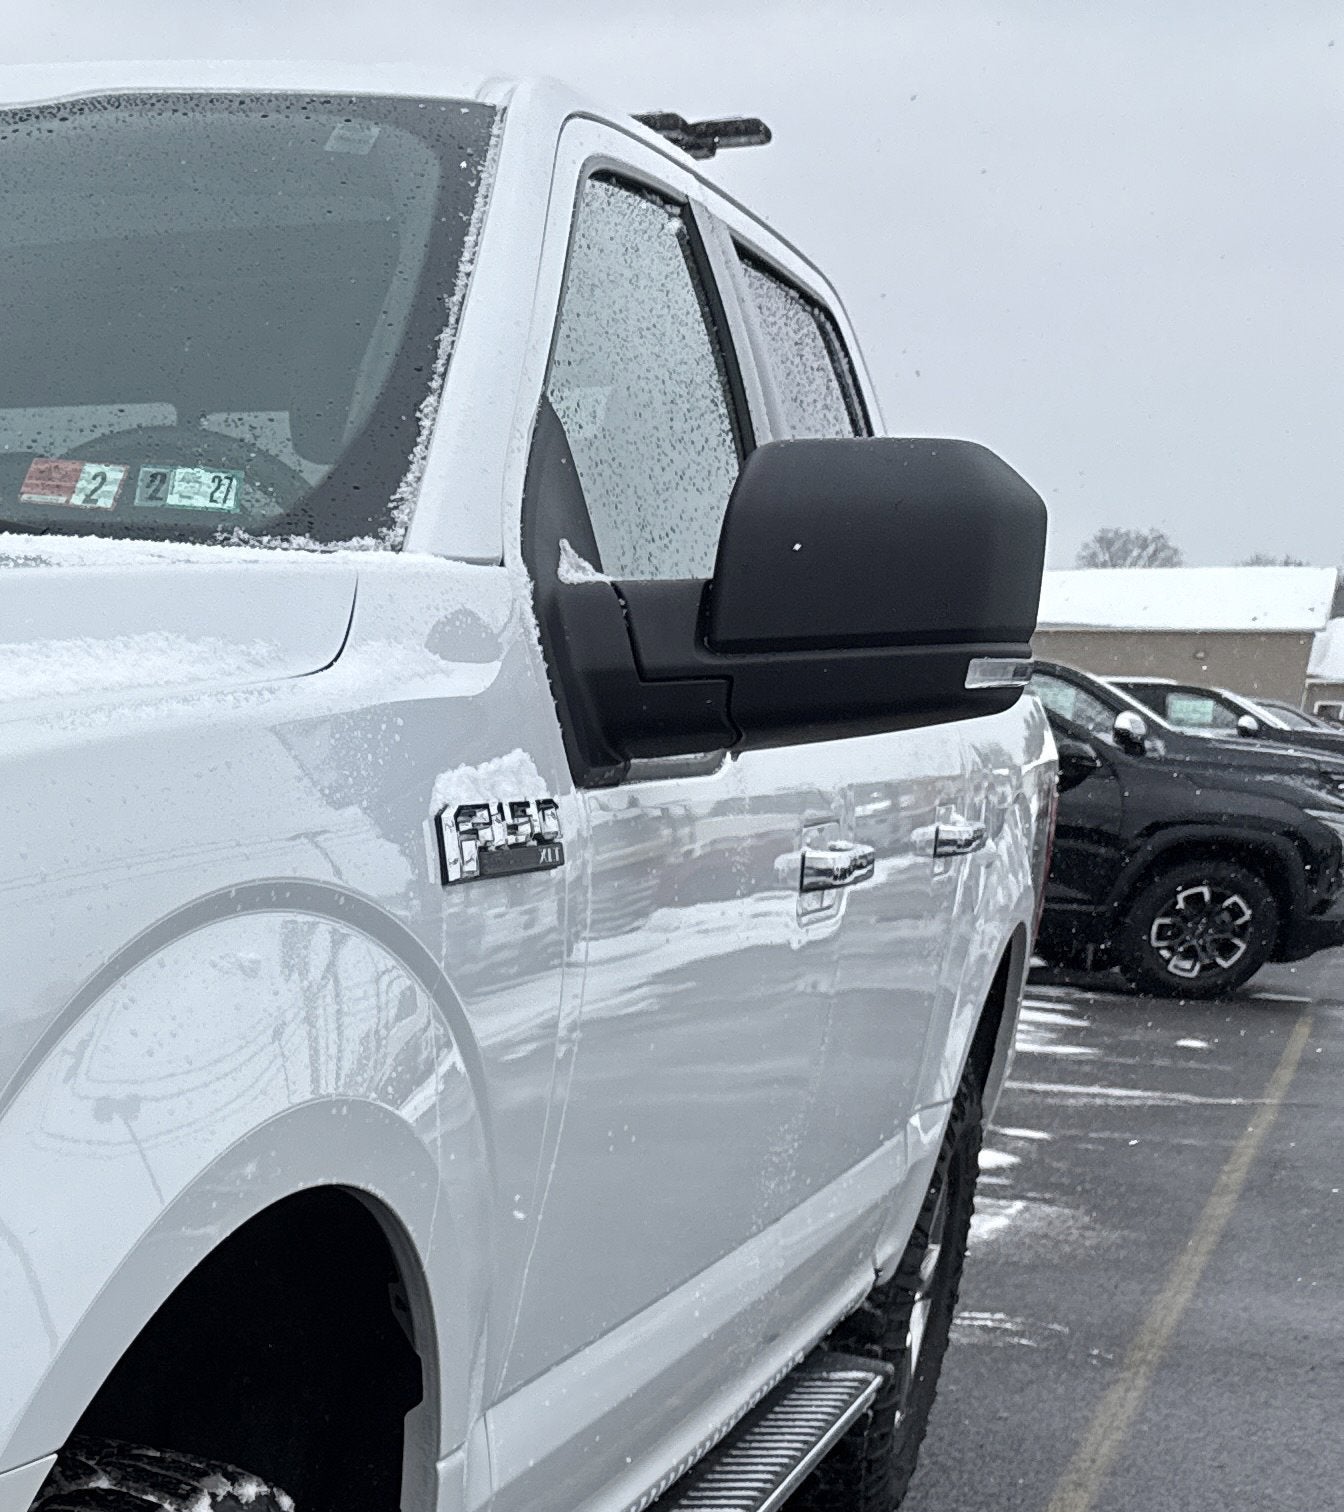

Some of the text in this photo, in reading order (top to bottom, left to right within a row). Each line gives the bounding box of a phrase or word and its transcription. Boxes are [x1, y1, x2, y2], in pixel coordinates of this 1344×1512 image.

[83, 471, 108, 504] 2
[146, 472, 168, 501] 2
[208, 474, 235, 505] 27
[539, 846, 561, 865] XLT
